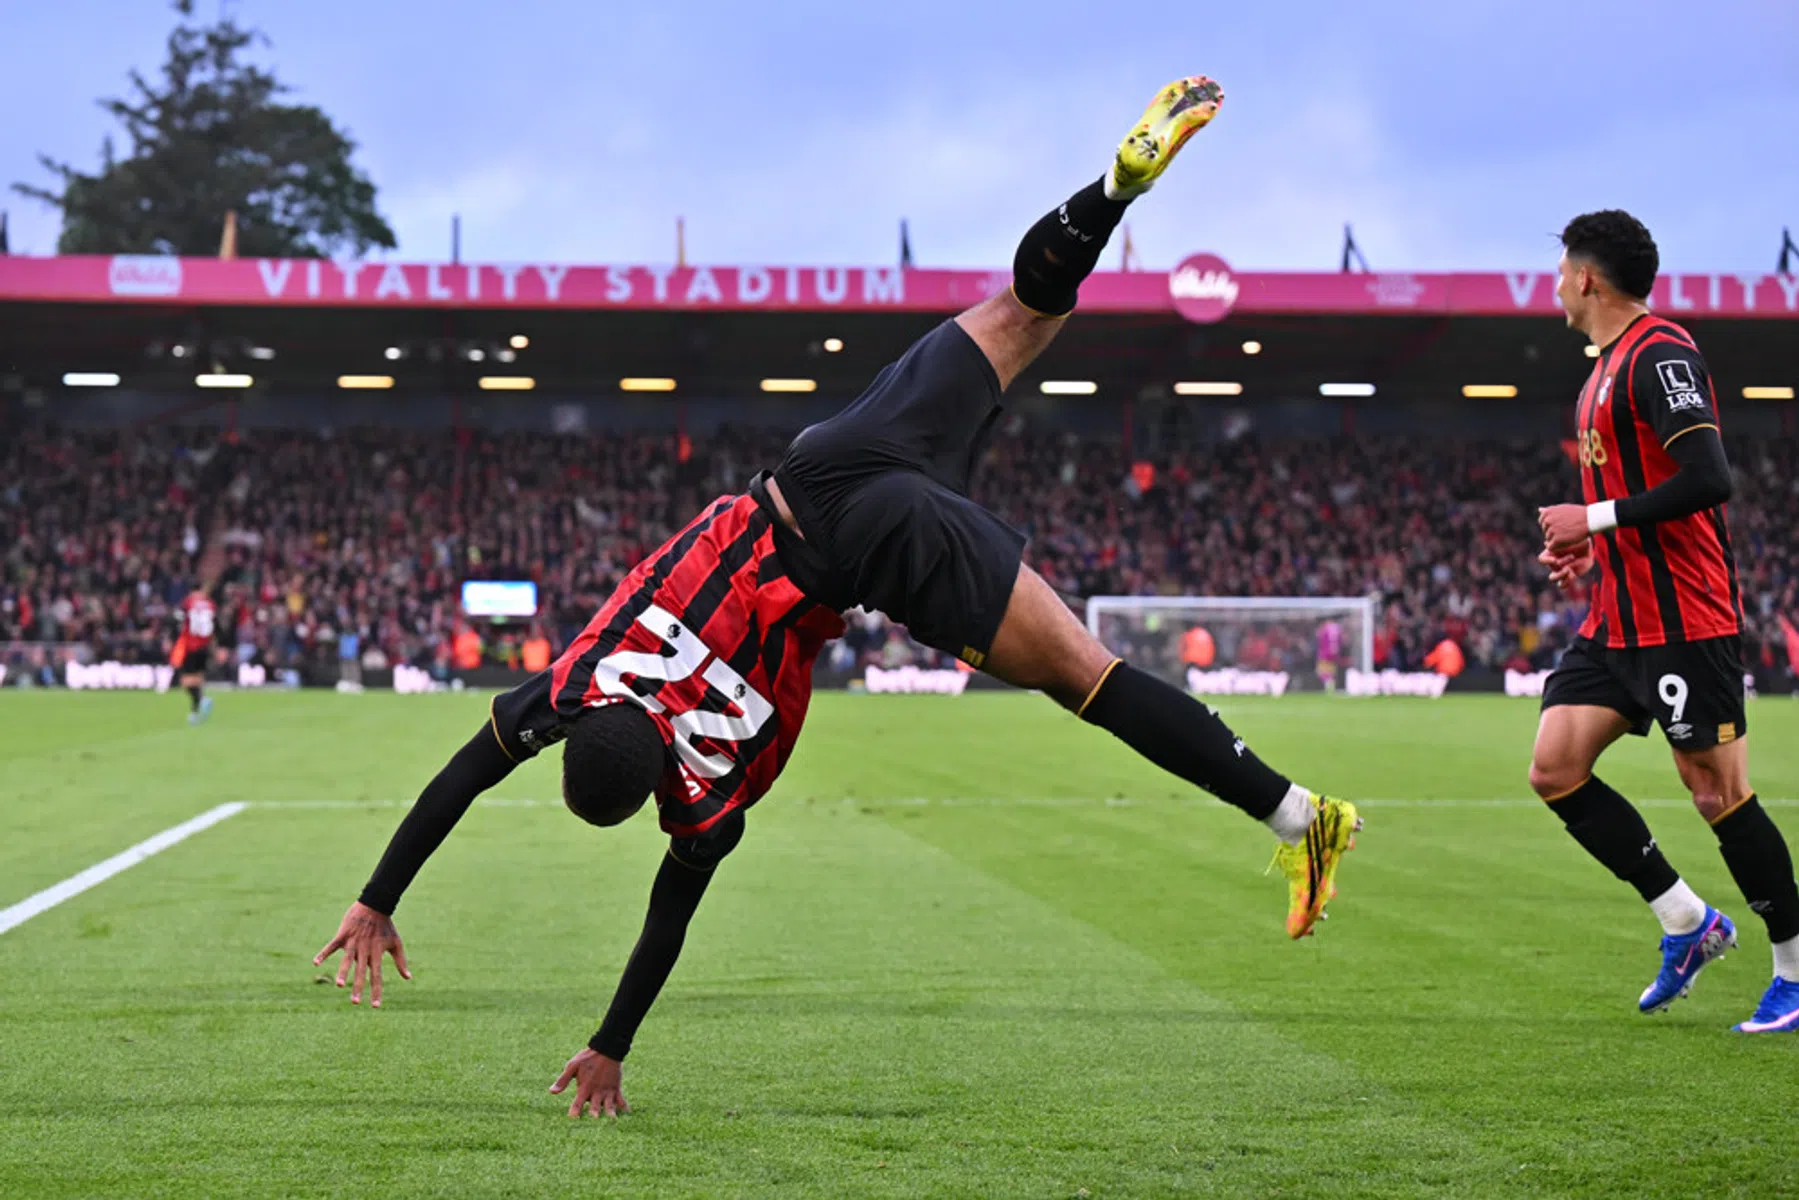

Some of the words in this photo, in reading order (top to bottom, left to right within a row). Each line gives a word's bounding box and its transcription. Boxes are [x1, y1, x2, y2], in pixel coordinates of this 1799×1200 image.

[257, 259, 569, 300] VITALITY
[604, 265, 905, 304] STADIUM
[1505, 271, 1799, 312] VLITY
[595, 604, 774, 778] 22
[1658, 673, 1689, 722] 9
